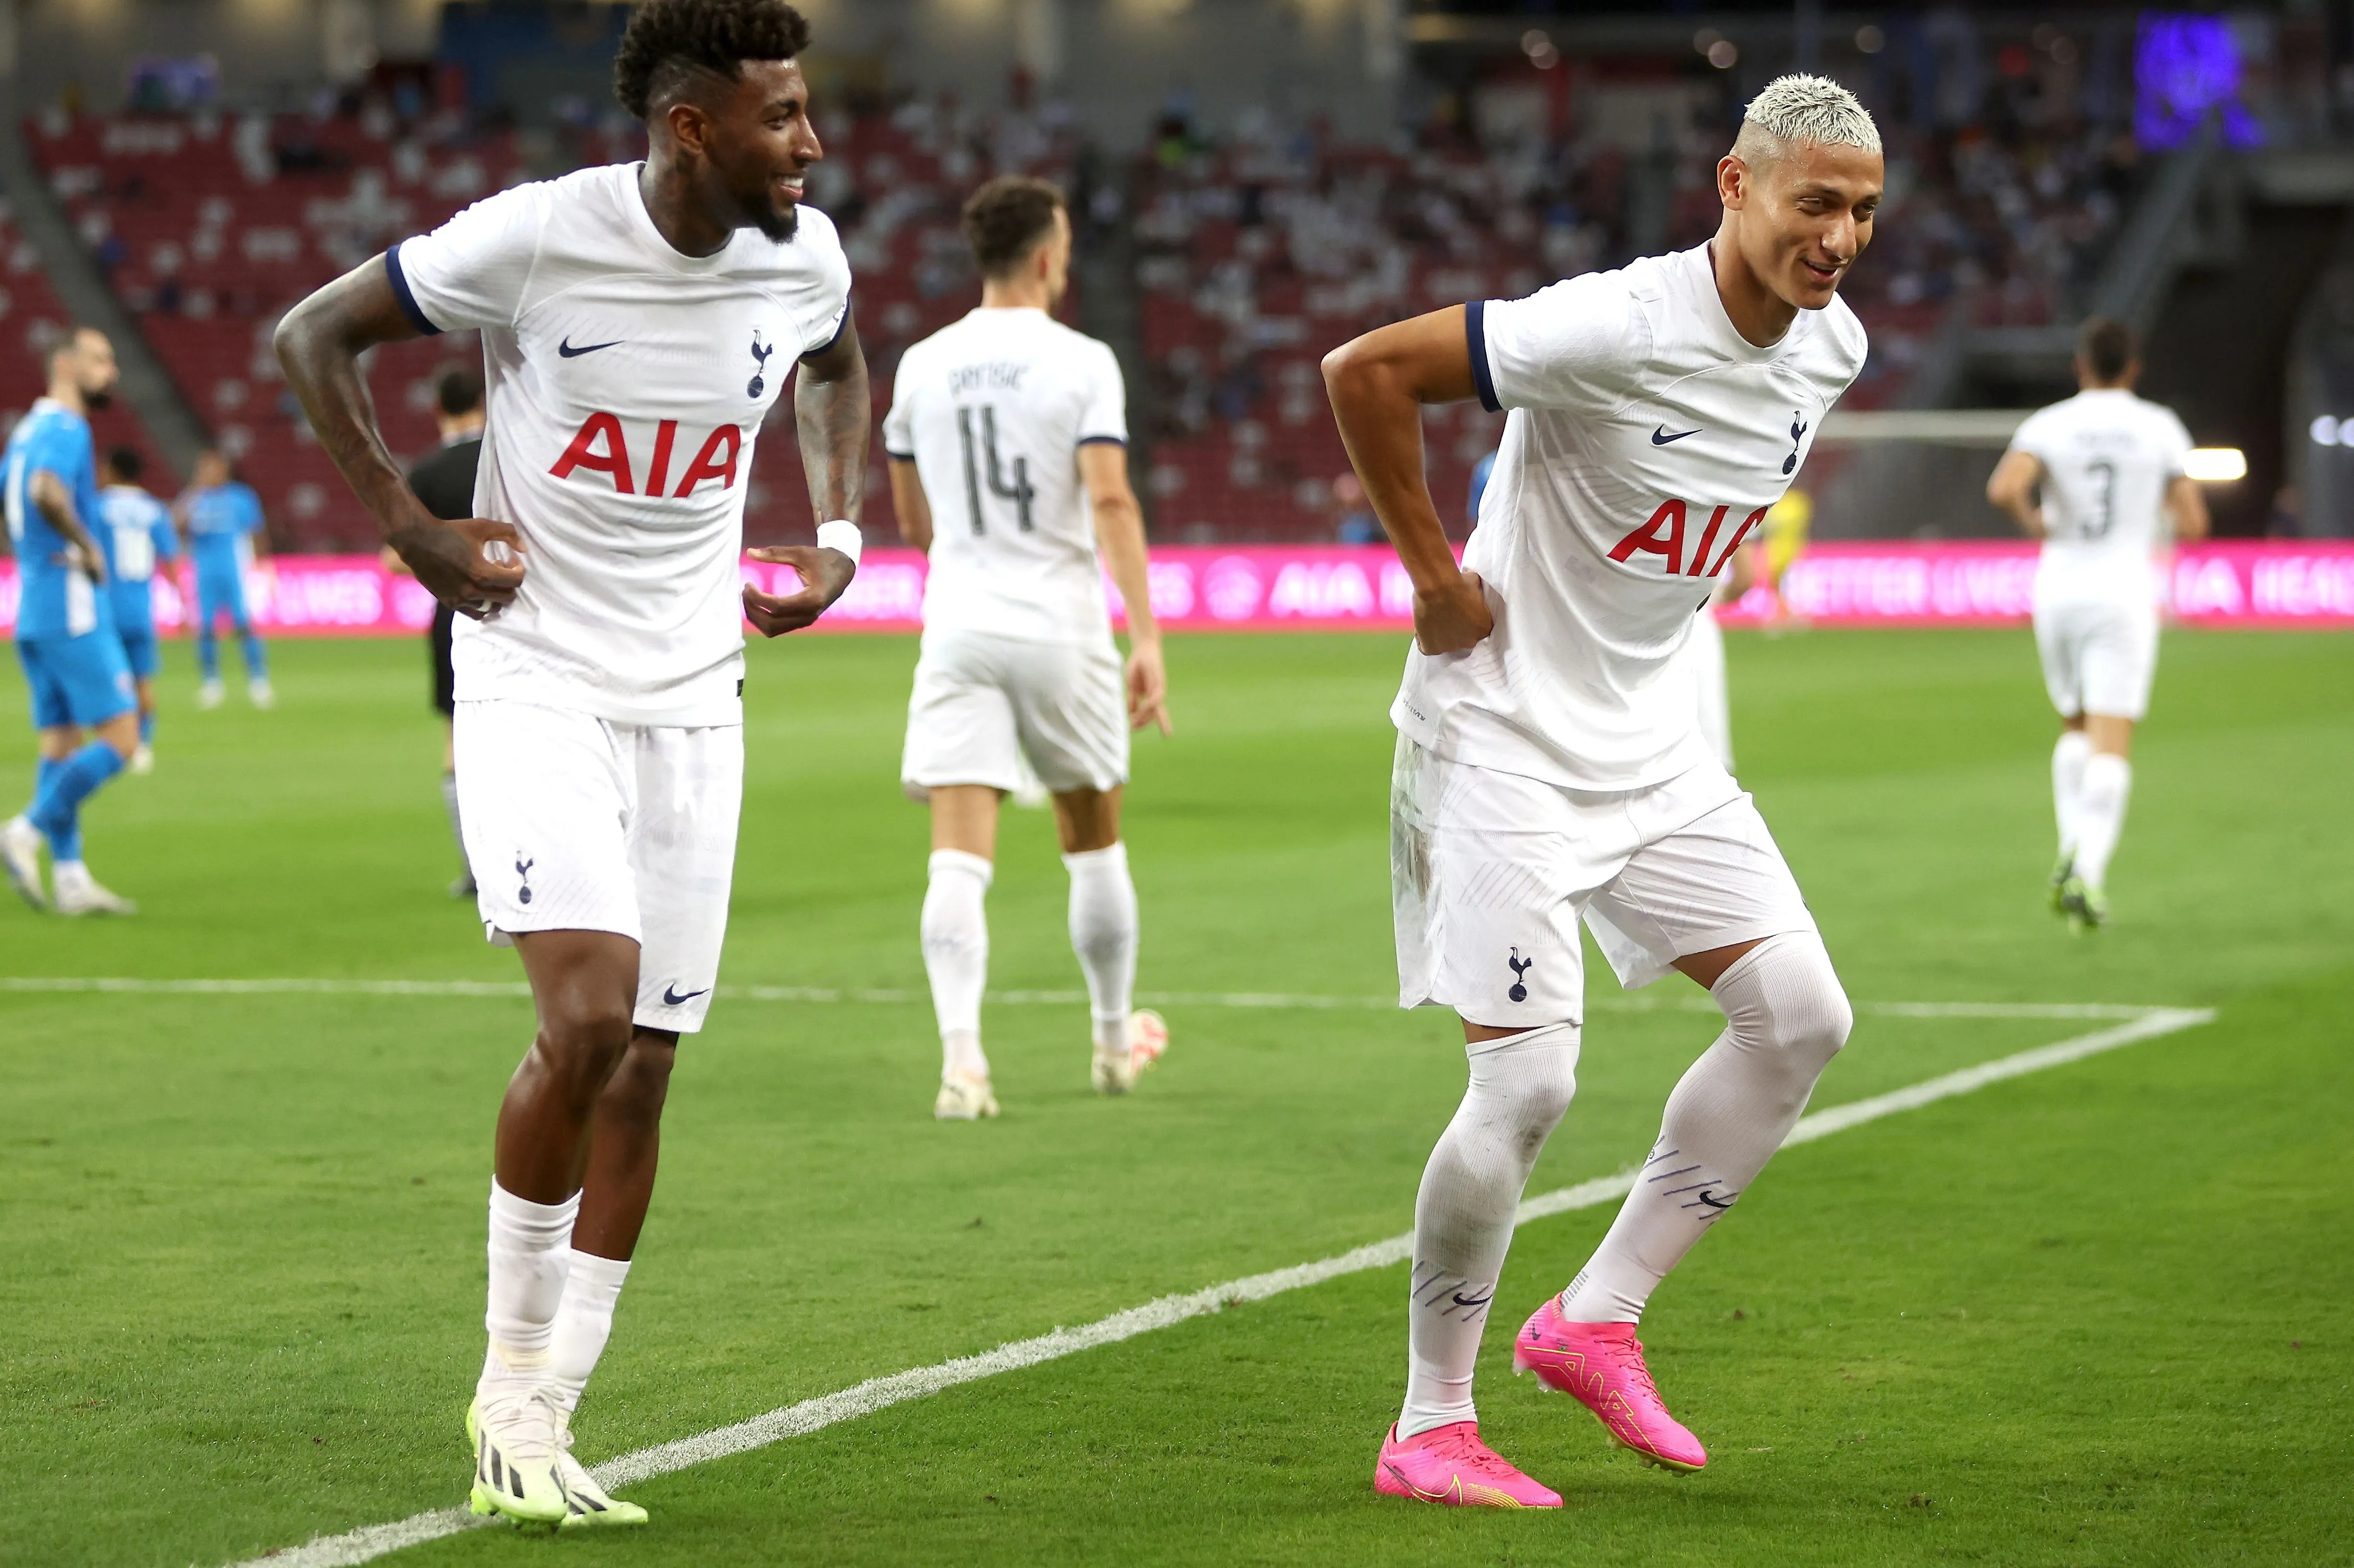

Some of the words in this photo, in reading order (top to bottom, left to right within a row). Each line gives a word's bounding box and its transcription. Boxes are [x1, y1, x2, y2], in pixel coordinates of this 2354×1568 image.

[548, 412, 741, 498] AIA
[957, 406, 1035, 537] 14
[2080, 456, 2117, 541] 3
[1268, 561, 1375, 618] AIA
